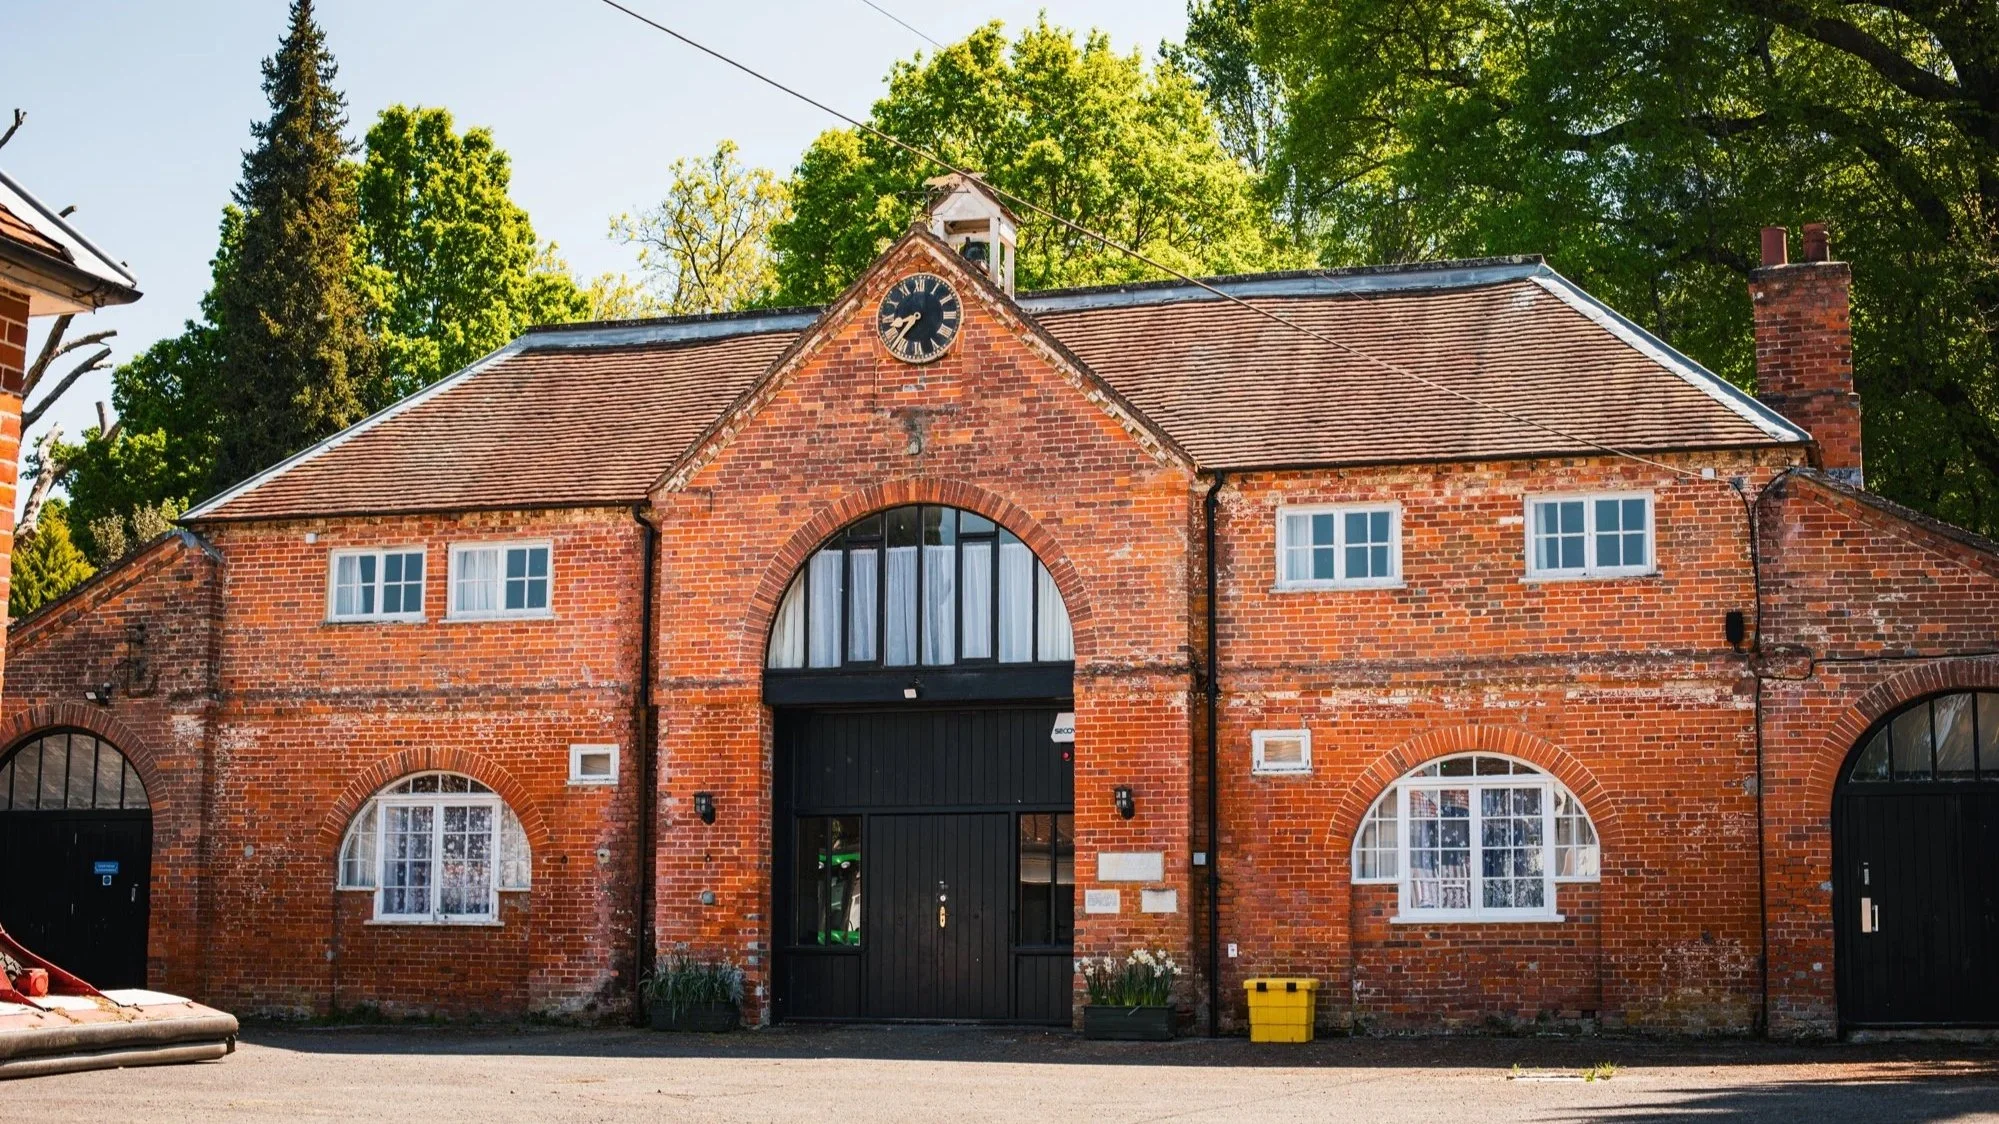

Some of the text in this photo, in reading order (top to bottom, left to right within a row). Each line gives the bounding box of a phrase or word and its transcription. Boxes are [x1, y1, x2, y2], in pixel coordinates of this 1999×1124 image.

[914, 279, 925, 292] XII
[930, 283, 939, 295] I
[939, 294, 953, 305] II
[943, 311, 956, 319] III
